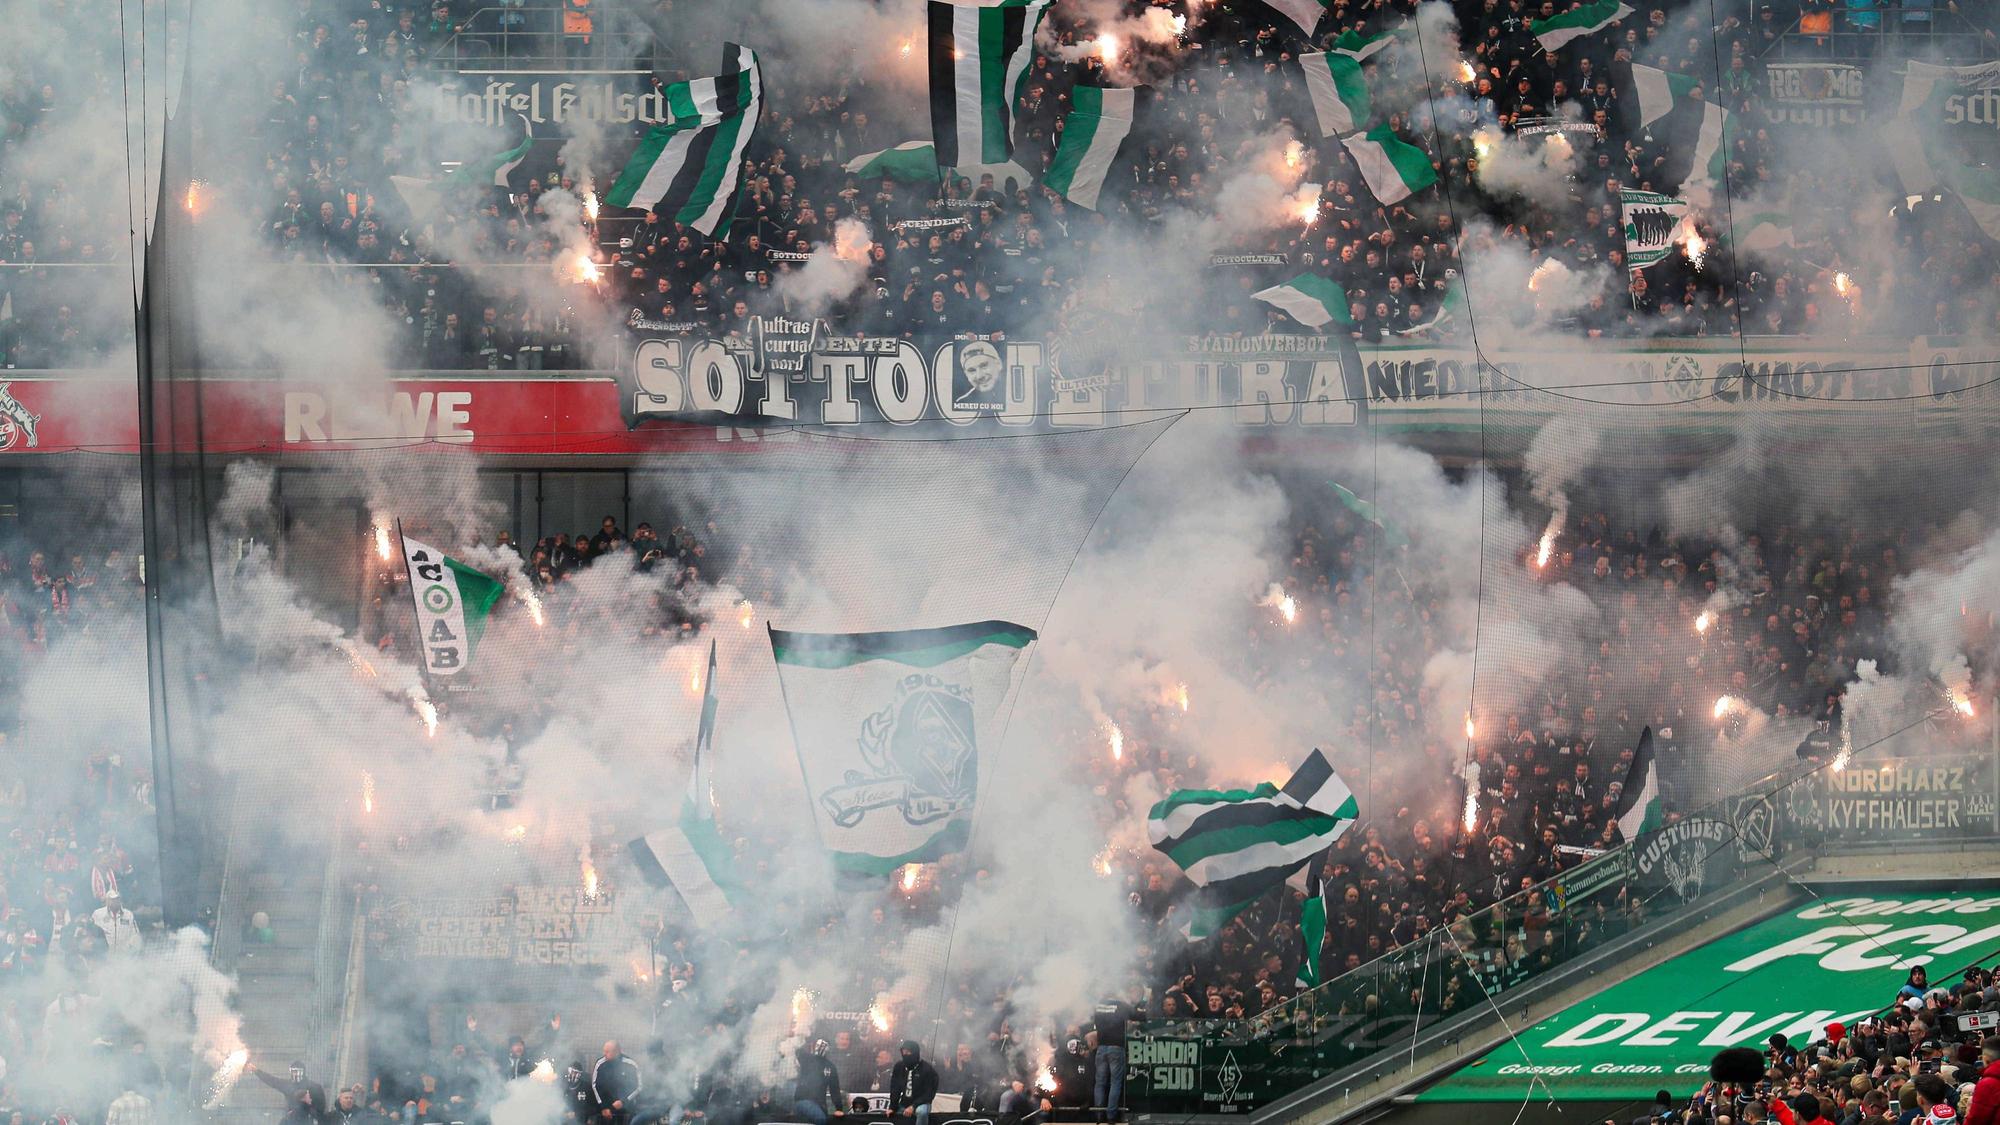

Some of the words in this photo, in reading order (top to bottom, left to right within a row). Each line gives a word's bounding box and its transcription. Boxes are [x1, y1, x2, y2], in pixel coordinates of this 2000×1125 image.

[764, 316, 810, 334] ultras
[765, 339, 809, 353] curva
[771, 354, 806, 372] nord
[1060, 376, 1106, 391] ULTRAS
[1828, 767, 1965, 793] NORDHARZ
[1828, 798, 1960, 829] KYFFHÄUSER
[1638, 817, 1724, 875] CUSTODES
[1127, 1040, 1199, 1065] BANDA
[1153, 1066, 1195, 1091] SUD
[1223, 1066, 1236, 1082] 15
